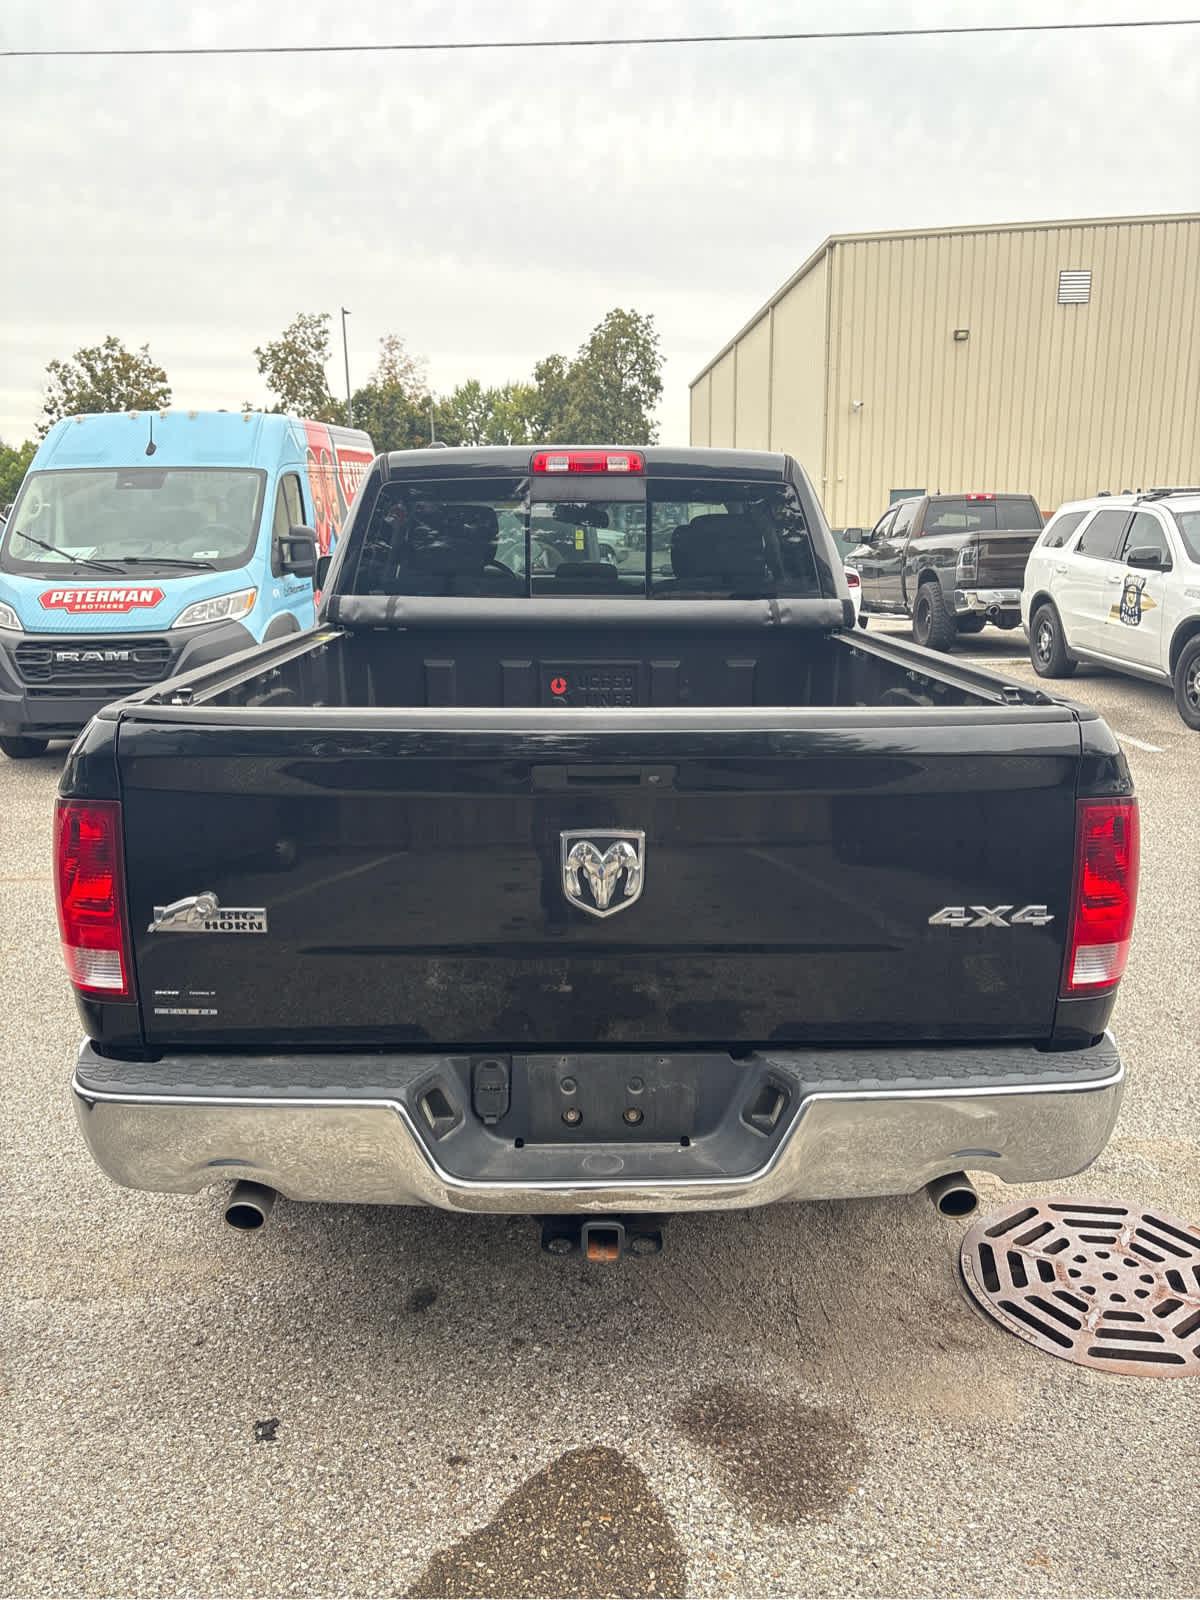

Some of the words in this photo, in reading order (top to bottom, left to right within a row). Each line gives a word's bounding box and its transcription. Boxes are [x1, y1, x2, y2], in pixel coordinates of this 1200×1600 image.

[50, 590, 154, 604] PETERMAN
[56, 651, 129, 662] RAM
[219, 911, 256, 920] BIG
[929, 904, 1055, 928] 4X4
[204, 921, 263, 931] HORN
